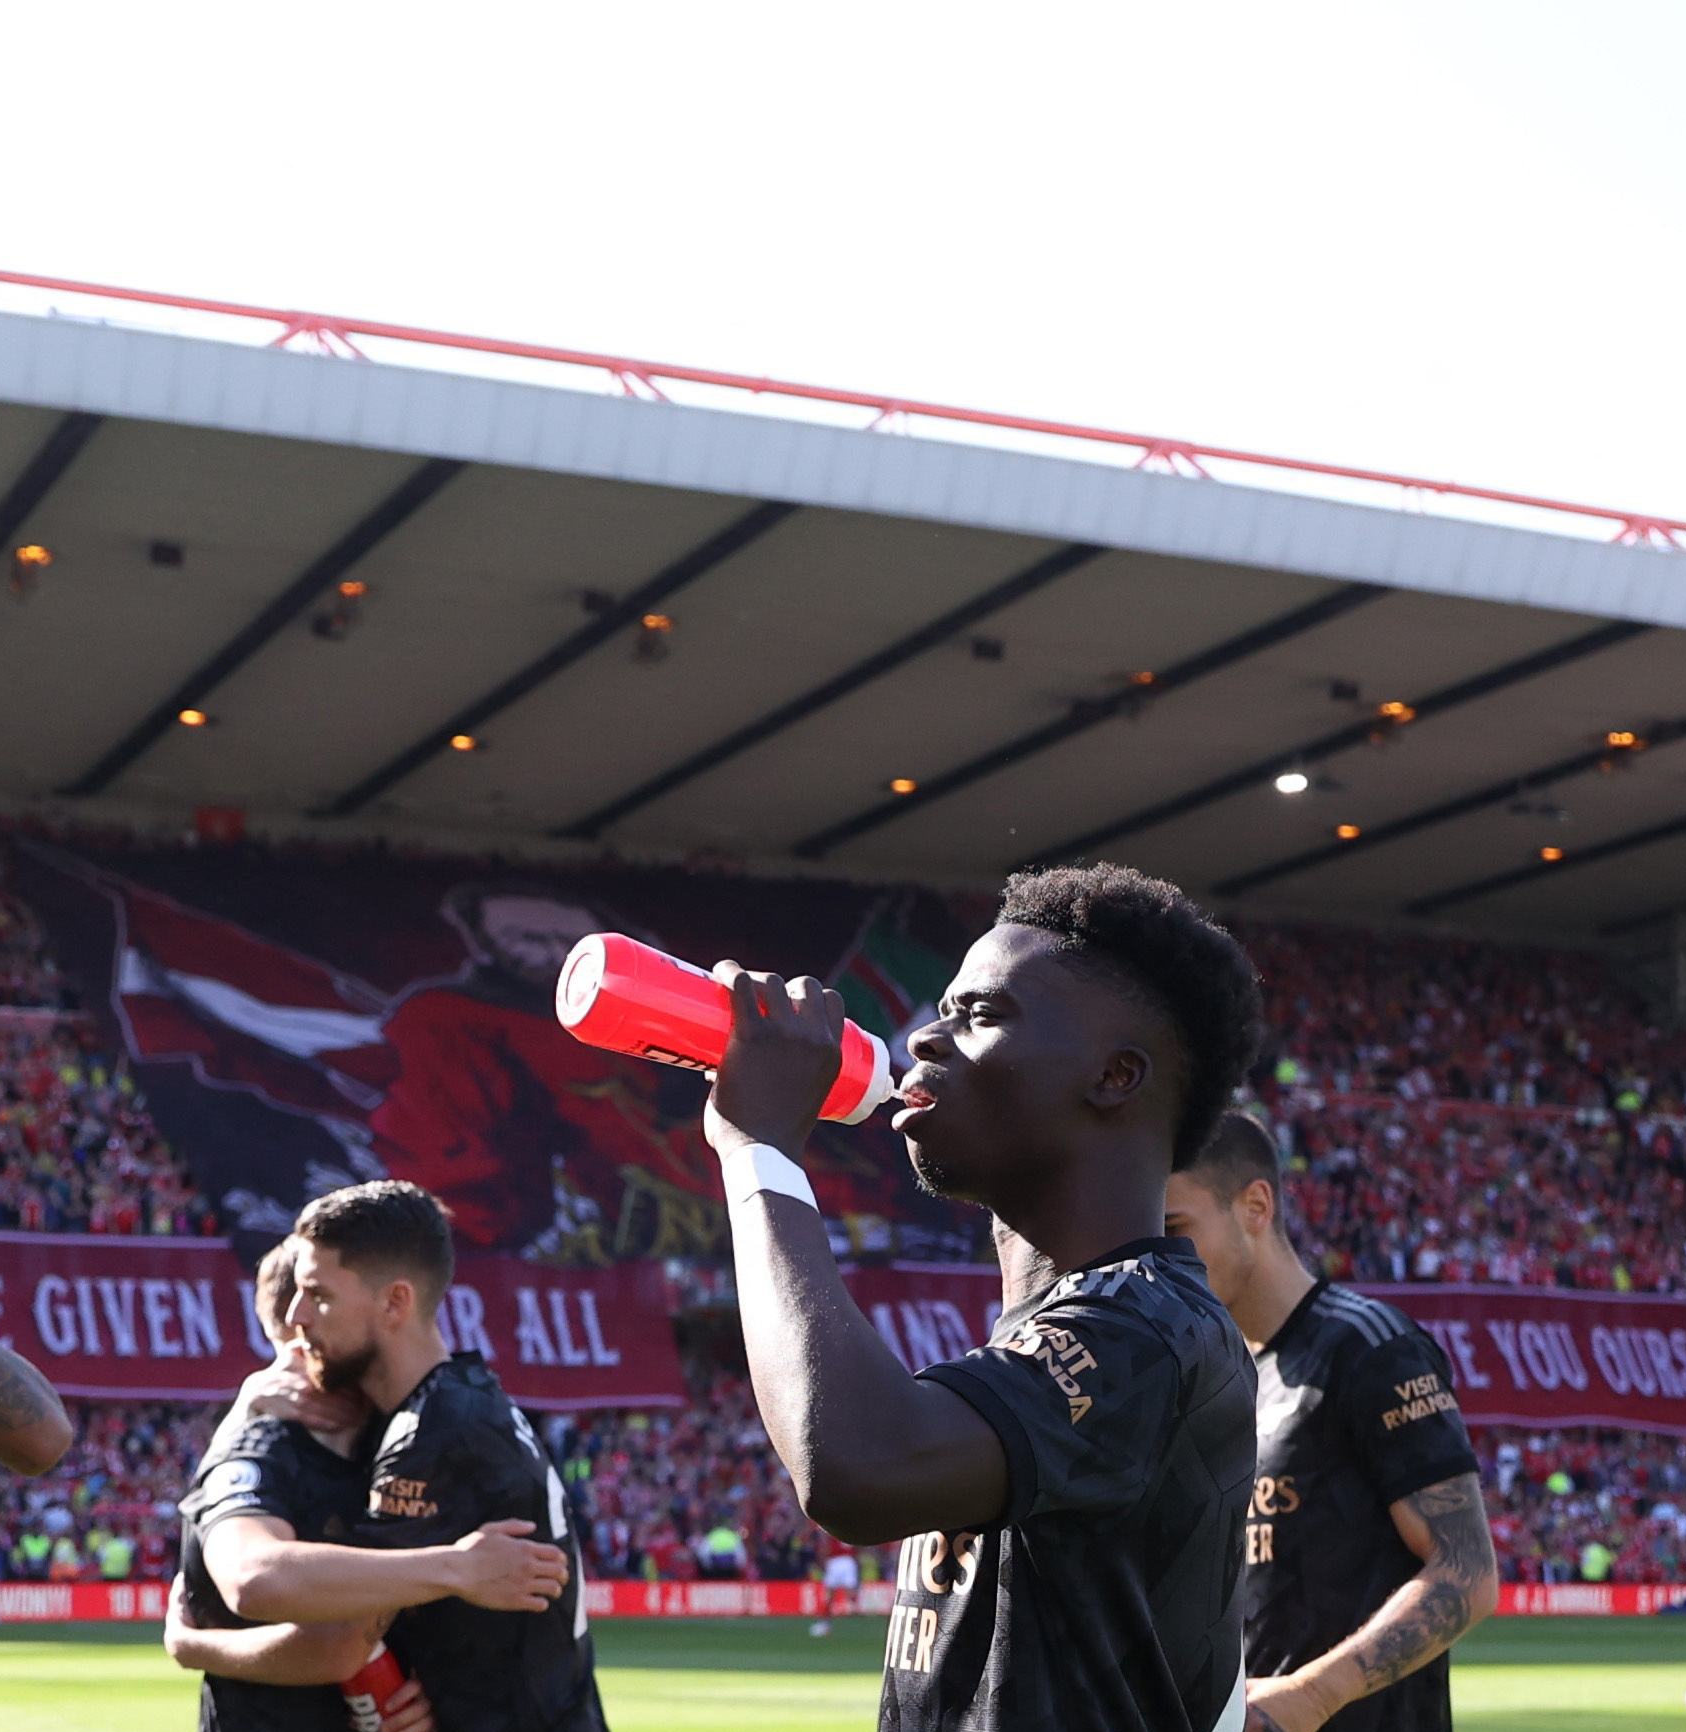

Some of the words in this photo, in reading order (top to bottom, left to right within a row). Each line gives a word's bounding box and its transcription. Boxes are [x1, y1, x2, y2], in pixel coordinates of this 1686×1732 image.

[33, 1274, 223, 1358] GIVEN
[517, 1287, 619, 1367] ALL
[1487, 1319, 1589, 1392] YOU
[1394, 1373, 1439, 1401] VISIT
